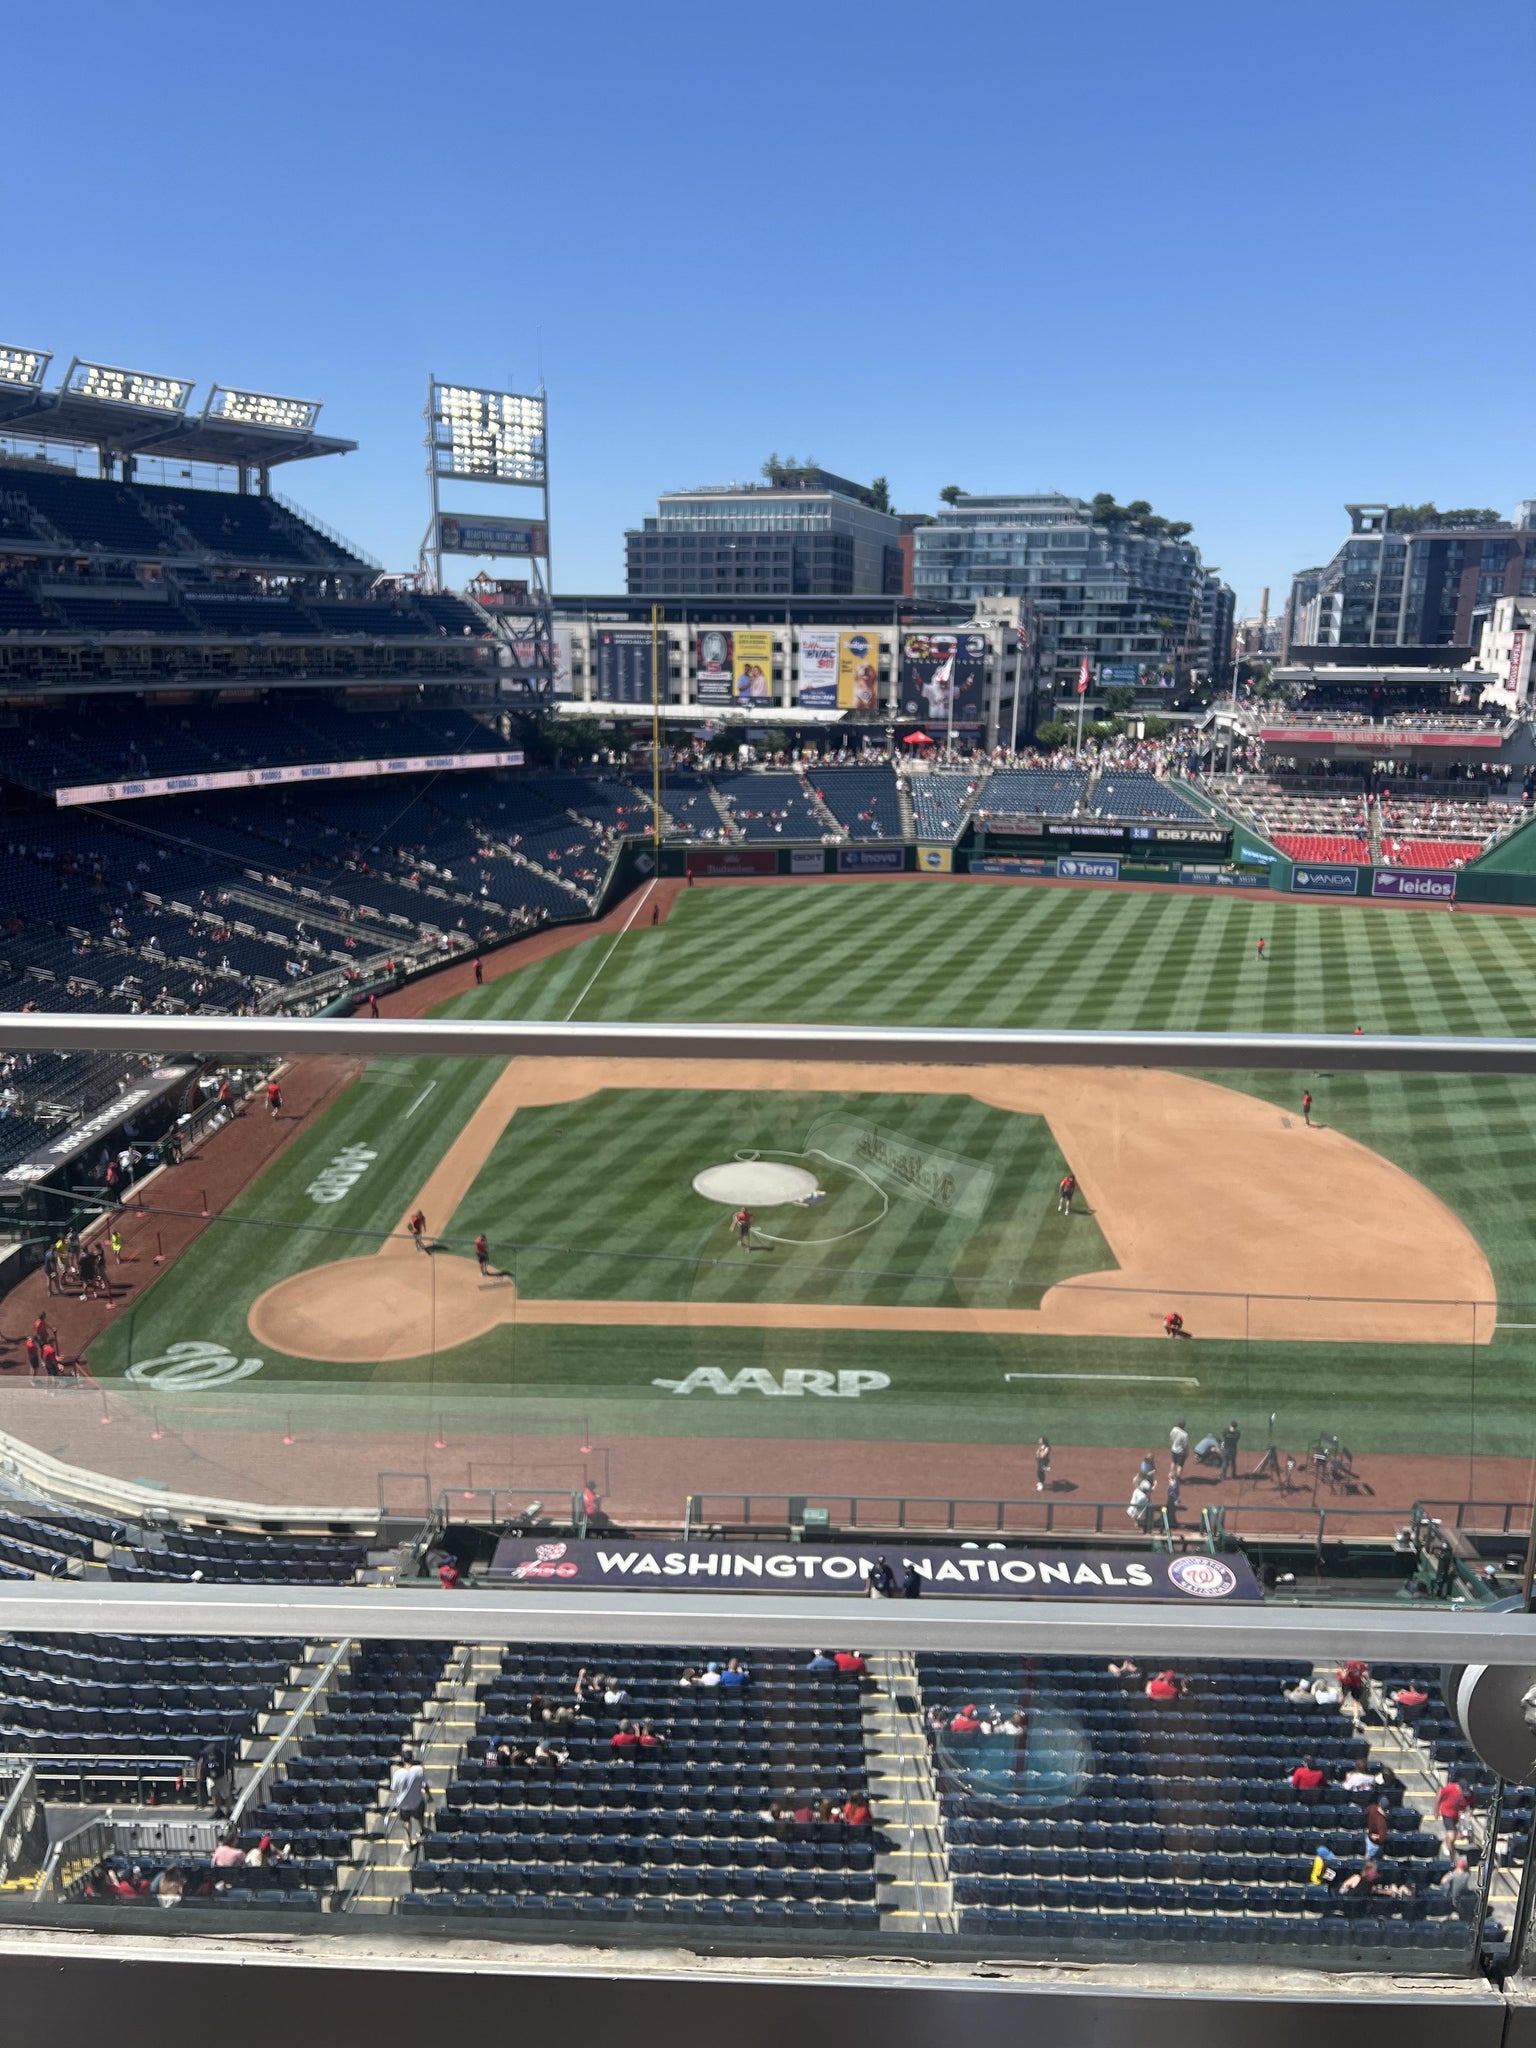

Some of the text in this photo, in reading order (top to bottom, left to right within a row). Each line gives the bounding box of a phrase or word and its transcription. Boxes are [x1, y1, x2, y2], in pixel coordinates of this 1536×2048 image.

[1384, 732, 1403, 744] FOR
[1404, 733, 1424, 744] YOU
[1190, 831, 1222, 842] FAN
[1077, 862, 1114, 876] Terra
[1309, 873, 1352, 885] VANDA
[1399, 877, 1452, 895] leidos
[651, 1366, 892, 1397] AARP
[902, 1557, 1154, 1587] NATIONALS
